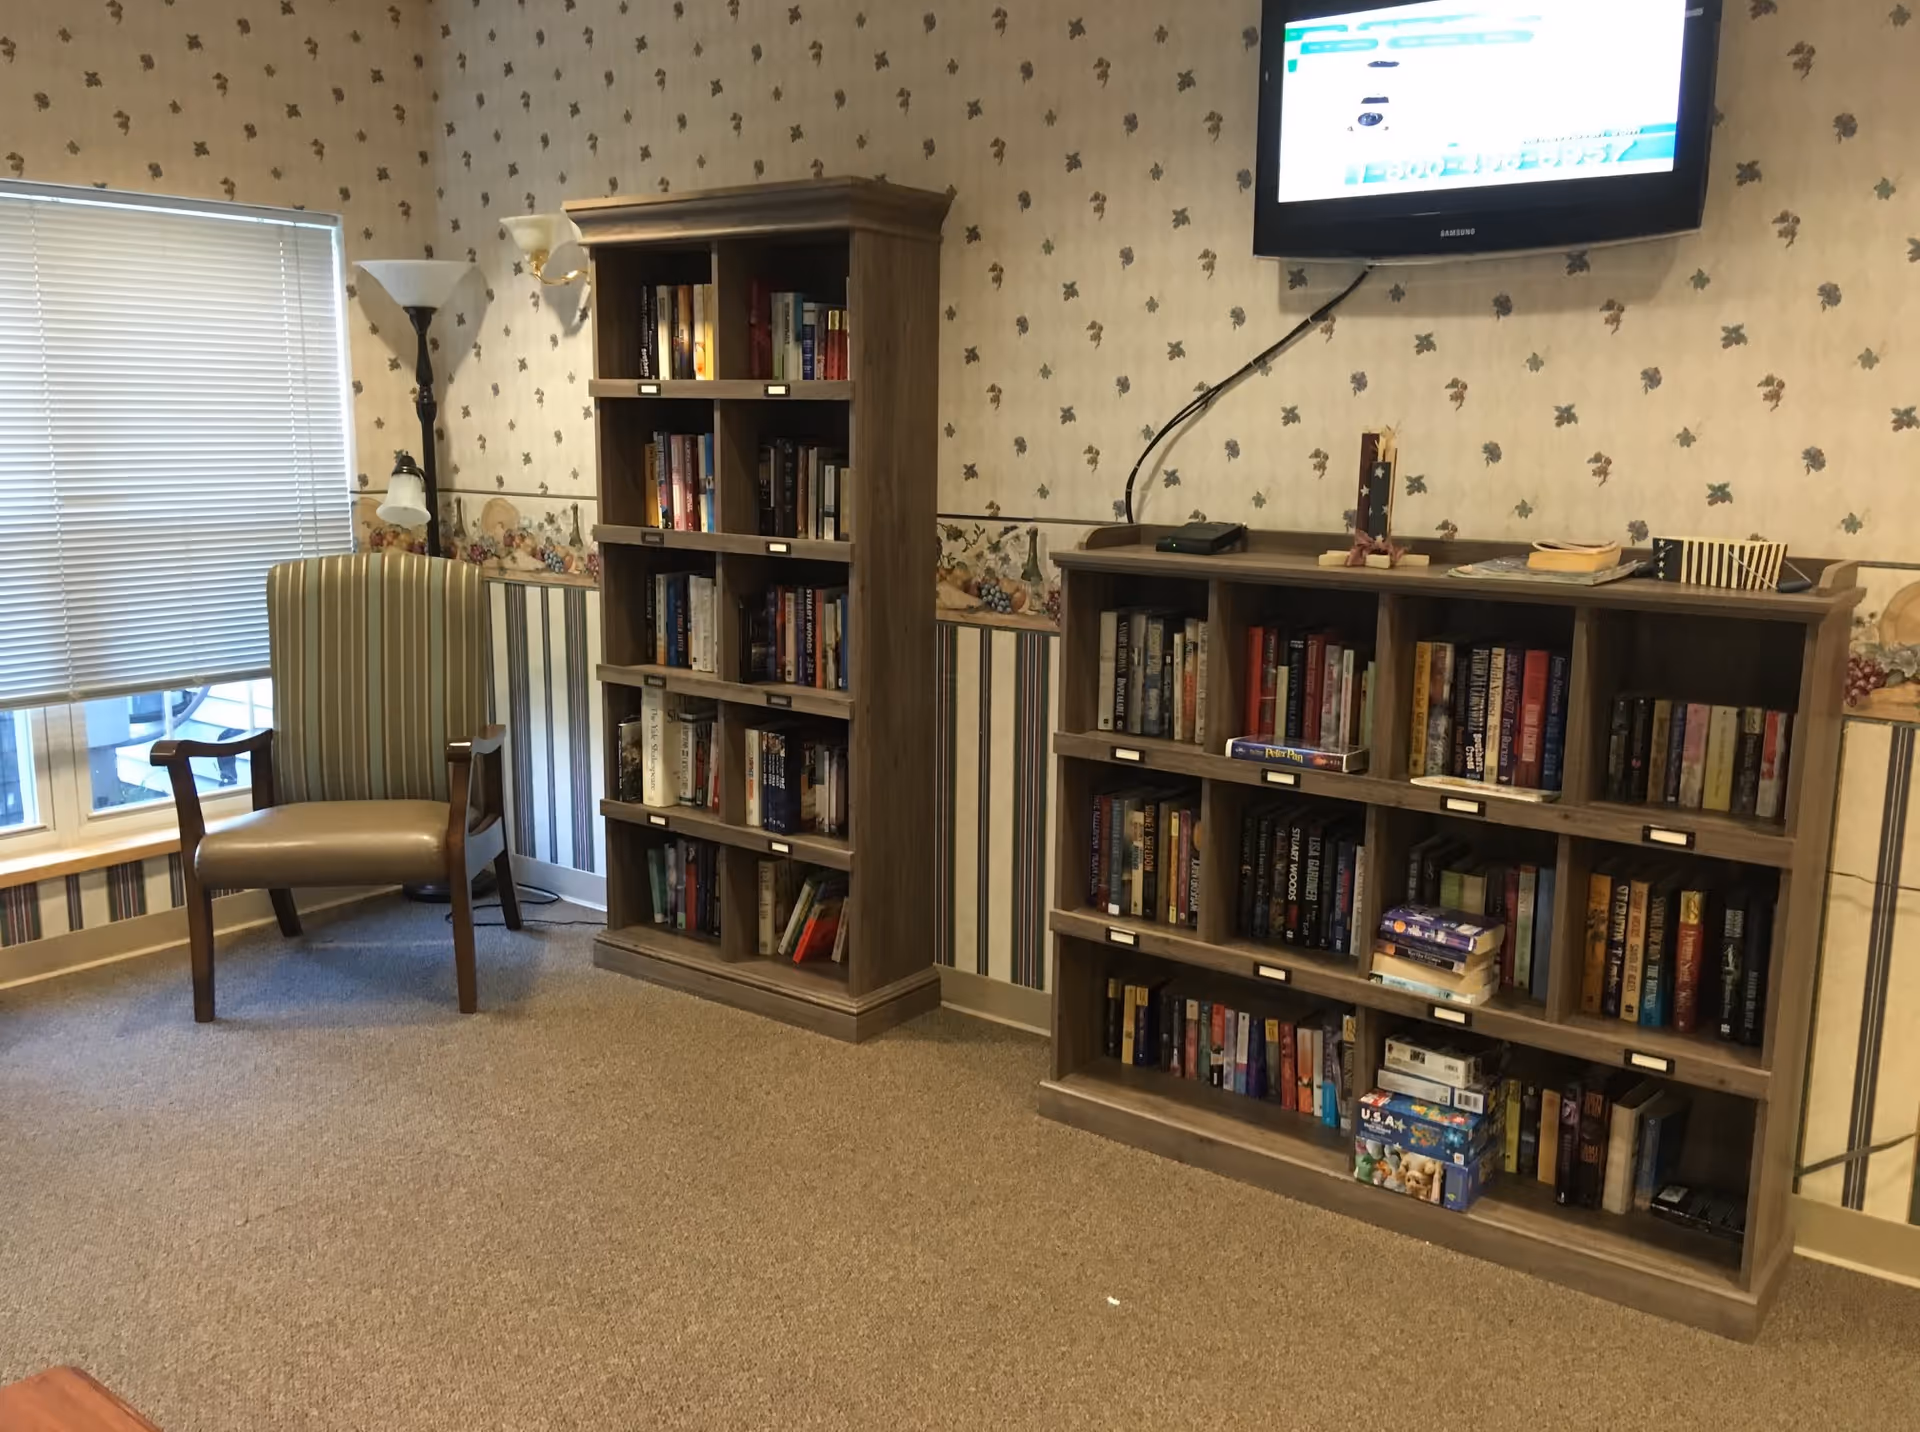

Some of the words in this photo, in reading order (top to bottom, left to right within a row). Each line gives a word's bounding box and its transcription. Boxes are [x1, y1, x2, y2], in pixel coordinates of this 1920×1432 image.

[1440, 228, 1476, 238] SAMSUNG
[805, 588, 813, 620] STUART
[1491, 652, 1504, 683] Judith
[650, 708, 658, 721] The
[650, 724, 658, 741] Yale
[649, 743, 658, 791] Shakespeare
[1265, 747, 1286, 758] Peter
[1287, 748, 1304, 763] Pan
[1144, 804, 1155, 833] SIDNEY
[1143, 835, 1154, 872] SHELDON
[1290, 827, 1301, 862] STUART
[1307, 837, 1321, 856] LISA
[1287, 863, 1299, 901] WOODS
[1305, 859, 1320, 901] GARDNER
[1361, 1107, 1397, 1129] U.S.A.
